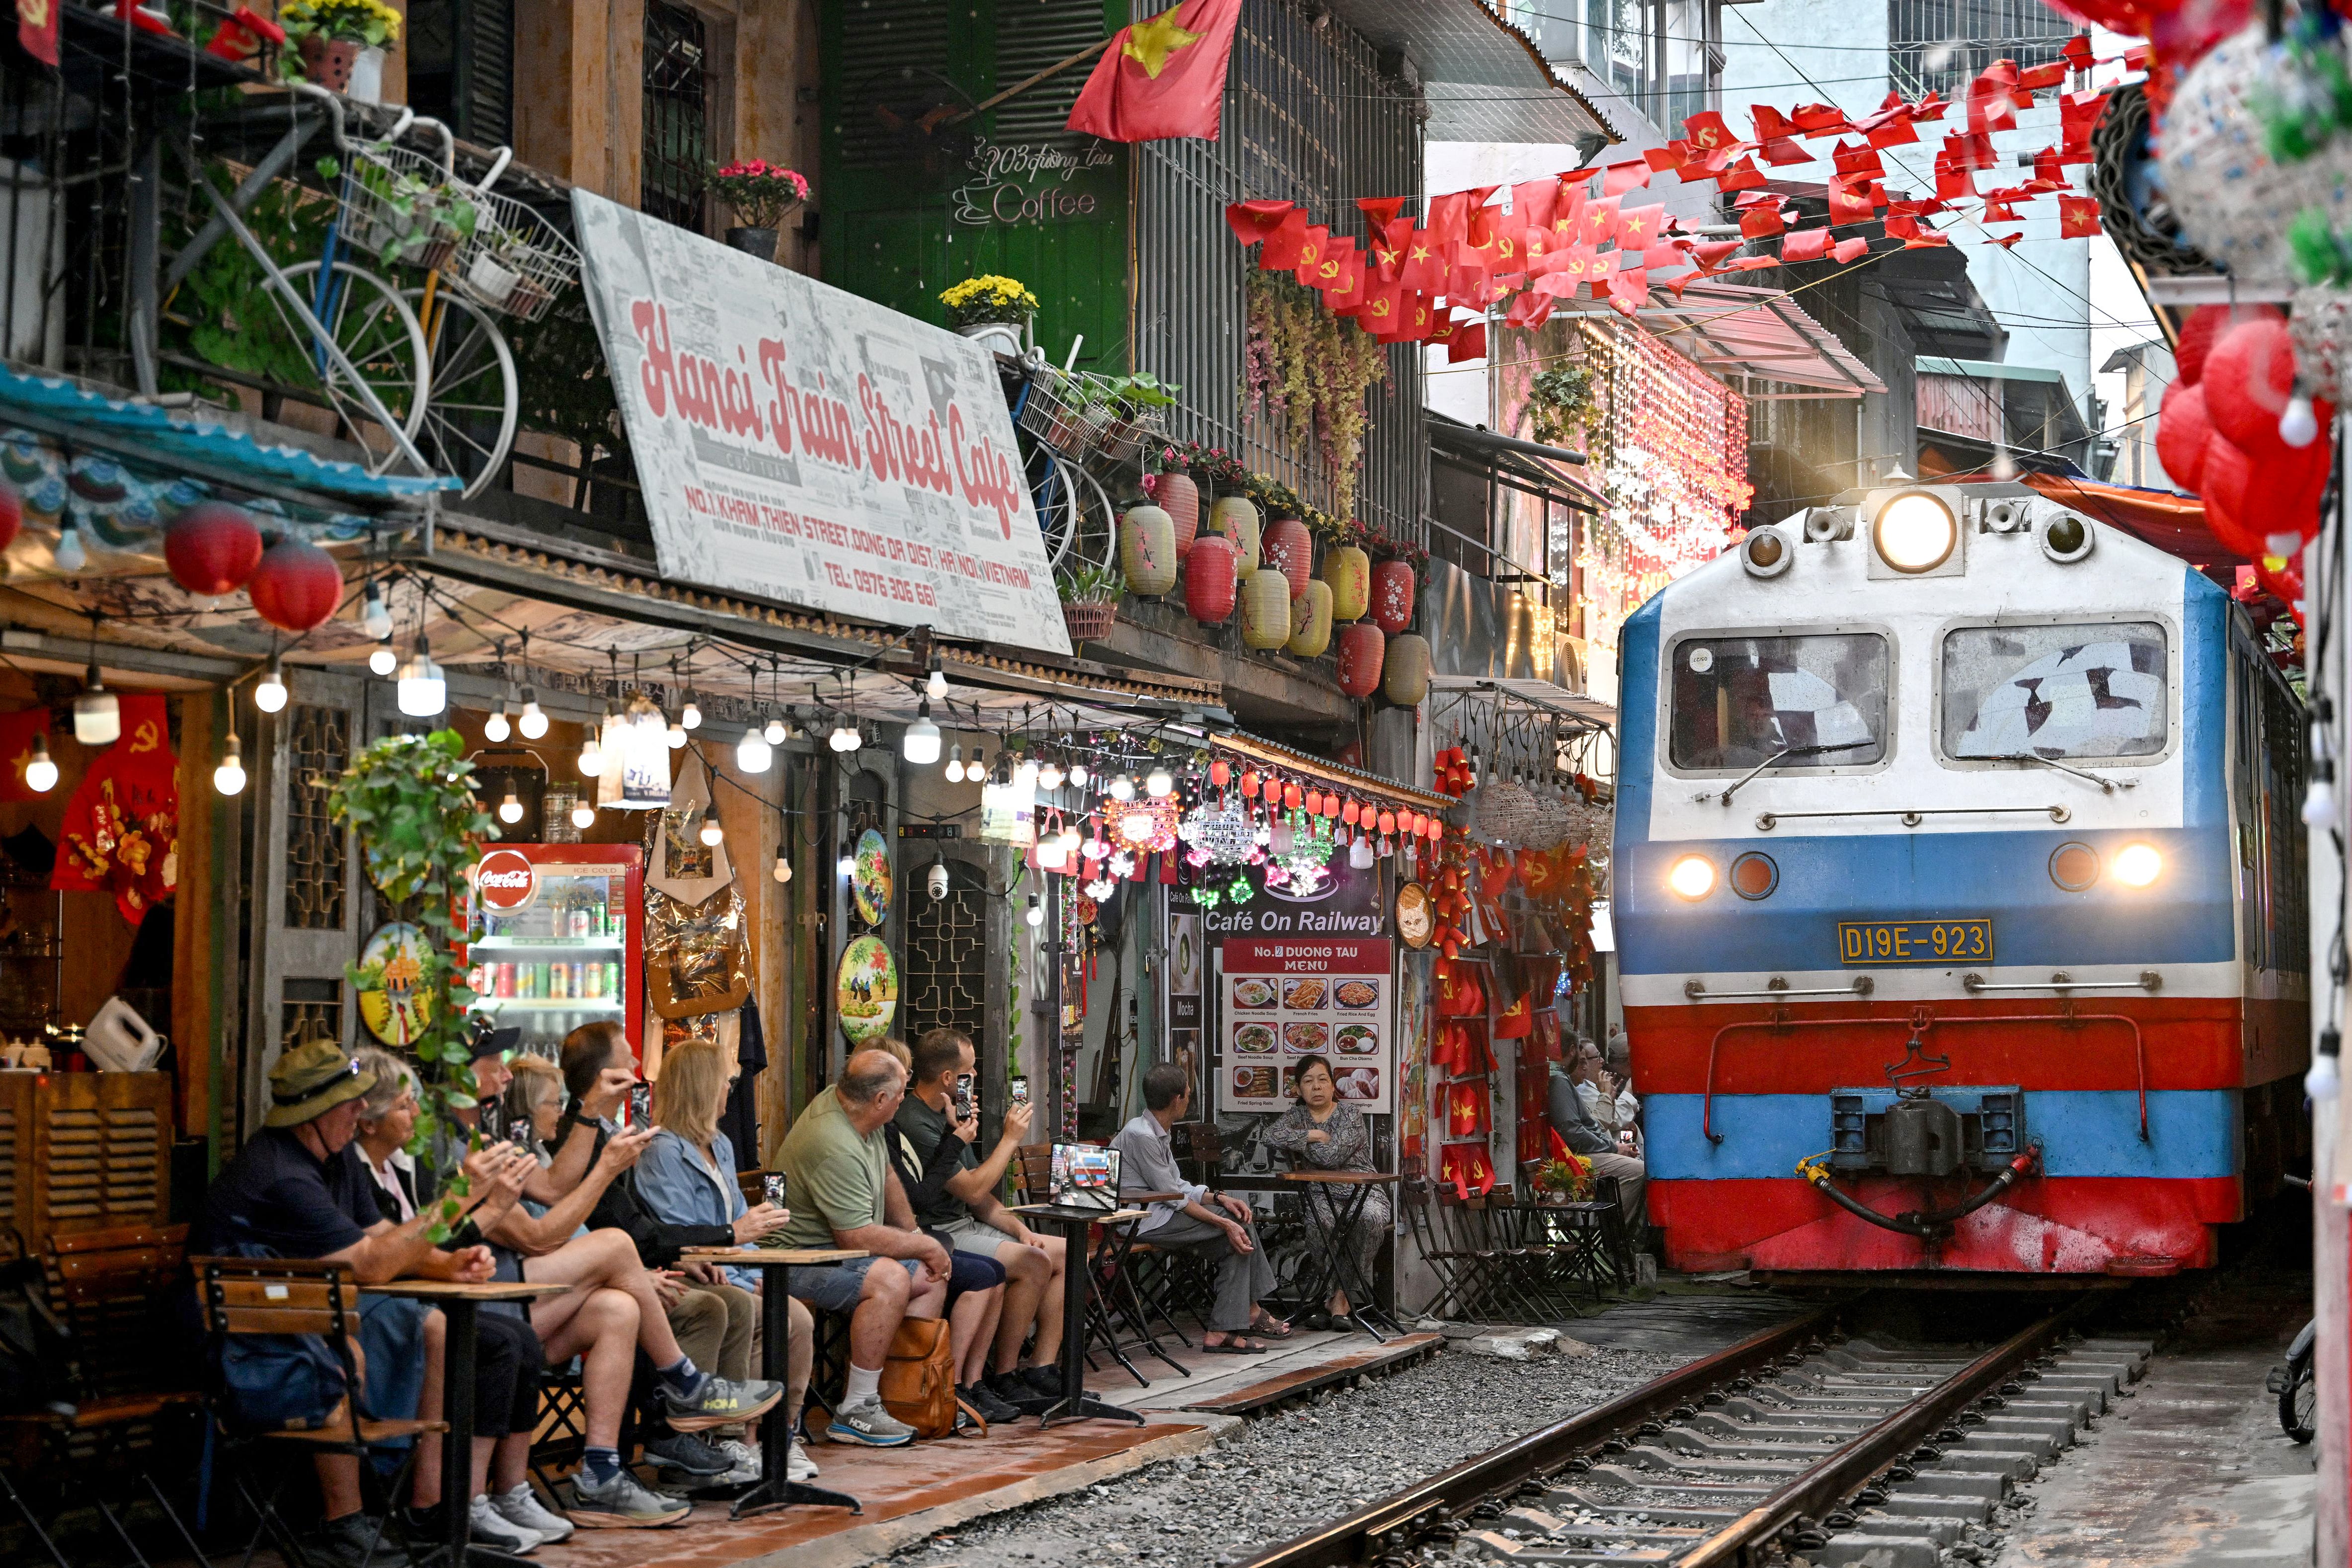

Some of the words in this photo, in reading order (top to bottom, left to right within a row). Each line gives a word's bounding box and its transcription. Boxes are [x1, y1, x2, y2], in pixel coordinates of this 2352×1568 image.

[993, 183, 1095, 223] Coffee
[631, 299, 764, 442] Hanoi
[759, 337, 861, 470] Train
[858, 372, 952, 496] Street
[948, 402, 1019, 540] Cafe
[684, 484, 716, 516] NO.1
[717, 493, 761, 528] KHAM
[761, 505, 802, 536] THIEN
[886, 537, 906, 562] DA
[938, 549, 958, 574] HA
[981, 559, 1031, 590] VIETNAM
[824, 561, 854, 590] TEL:
[853, 568, 888, 598] 0976
[888, 576, 914, 604] 306
[915, 582, 938, 608] 661
[1170, 891, 1178, 903] Café
[1179, 892, 1184, 903] On
[1205, 911, 1254, 931] Café
[1260, 911, 1291, 931] On
[1298, 911, 1385, 936] Railway
[1286, 946, 1332, 957] DUONG
[1335, 947, 1358, 957] TAU
[1846, 926, 1985, 957] D19E-923
[1284, 960, 1328, 971] MENU
[1177, 1001, 1194, 1016] Mocha
[703, 1398, 738, 1410] HOKA
[848, 1416, 872, 1433] HOKA
